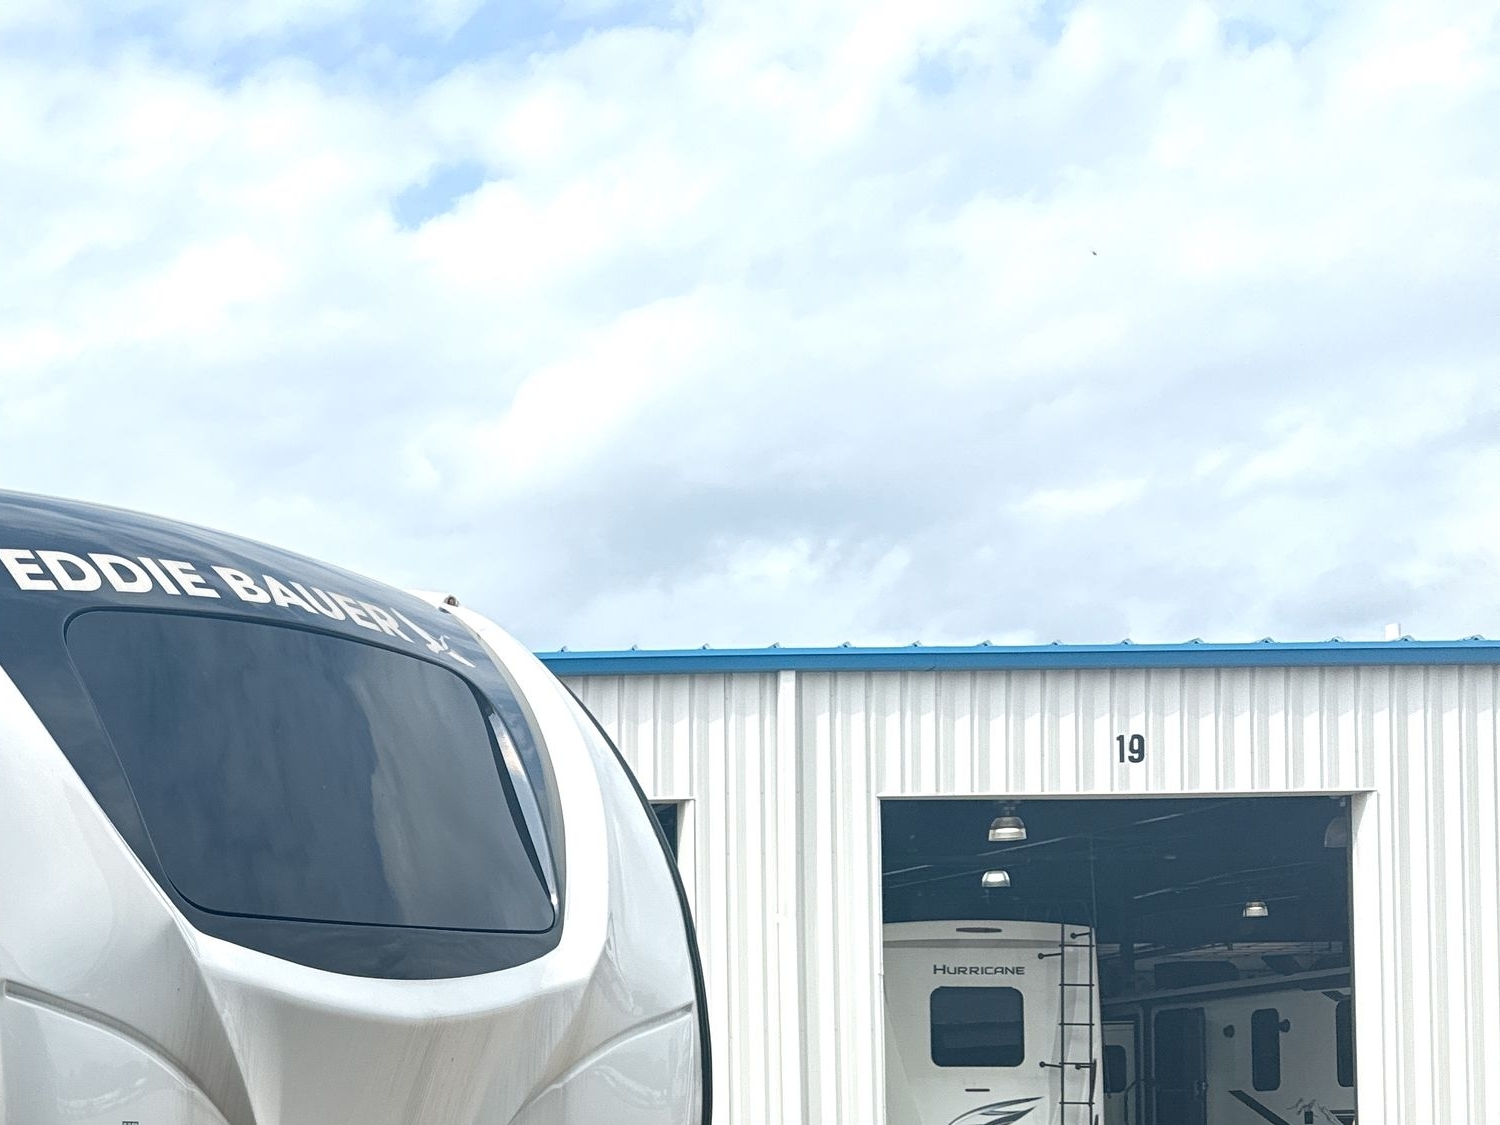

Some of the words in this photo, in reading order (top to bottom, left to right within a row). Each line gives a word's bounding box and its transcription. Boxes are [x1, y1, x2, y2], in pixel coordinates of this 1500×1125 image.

[210, 565, 415, 644] BAUER
[1116, 734, 1145, 763] 19
[933, 965, 1025, 975] HURRICANE
